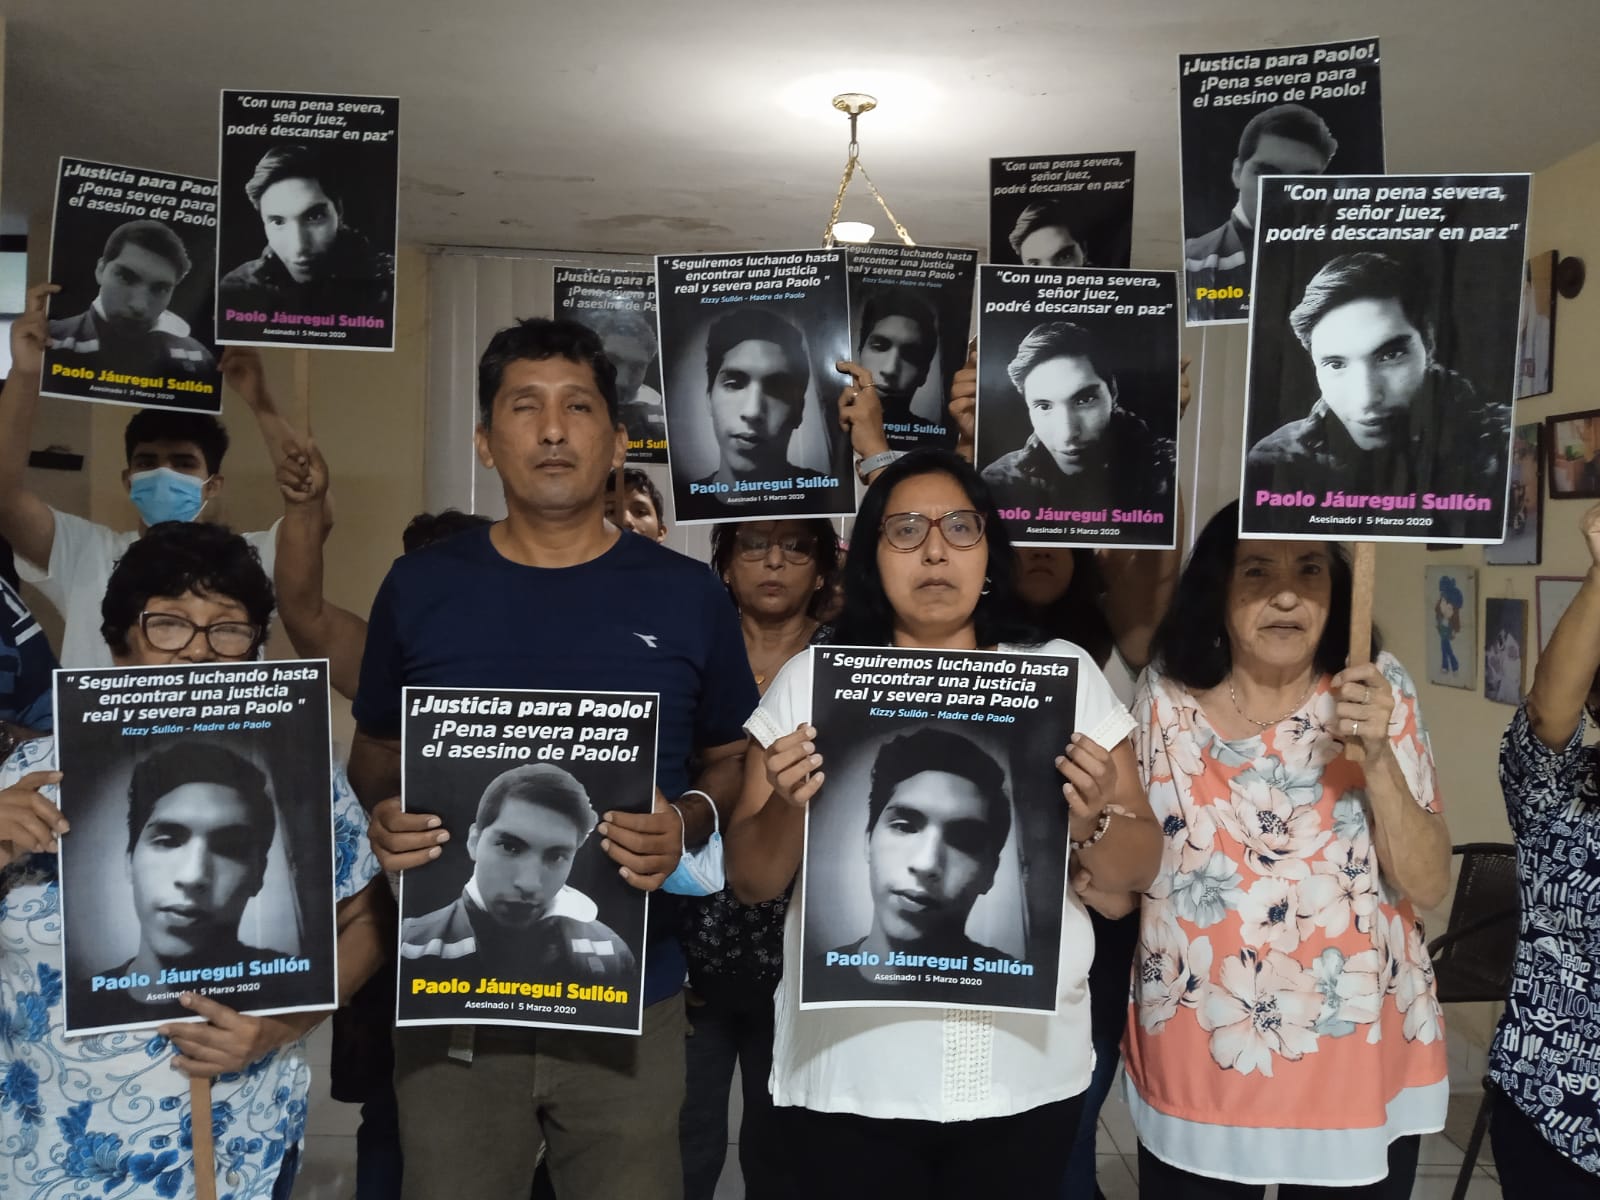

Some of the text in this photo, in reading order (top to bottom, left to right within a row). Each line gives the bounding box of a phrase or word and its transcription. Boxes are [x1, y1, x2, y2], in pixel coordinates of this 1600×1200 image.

[1183, 44, 1375, 76] ¡Justicia para Paolo!
[1200, 68, 1357, 93] ¡Pena severa para
[1193, 81, 1367, 107] el asesino de Paolo!
[238, 96, 385, 115] "Con una pena severa,
[273, 112, 347, 127] señor juez,
[227, 124, 394, 142] podré descansar paz"
[1002, 158, 1123, 171] "Con una pena severa,
[64, 164, 218, 196] ¡Justicia para Paol
[1031, 170, 1091, 182] señor juez,
[993, 179, 1130, 196] podré descansar paz"
[1284, 185, 1505, 202] "Con una pena severa,
[77, 182, 215, 212] ¡Pena severa para
[87, 199, 146, 216] asesino
[1336, 204, 1446, 222] señor juez,
[1266, 224, 1518, 242] podré descansar en paz"
[672, 253, 839, 270] Seguiremos luchando hasta
[853, 256, 955, 270] encontrar justicia
[900, 248, 973, 261] luchando hasta
[556, 271, 642, 285] ¡Justicia para
[685, 265, 818, 281] encontrar una justicia
[905, 270, 956, 280] para Paolo
[996, 271, 1161, 288] "Con una pena severa,
[674, 277, 821, 294] real severa para Paolo
[1197, 286, 1243, 300] Paolo
[1037, 288, 1120, 301] señor juez,
[985, 300, 1173, 316] podré descansar en paz"
[226, 309, 385, 329] Paolo Jáuregui Sullón
[52, 364, 213, 394] Paolo Jáuregui Sullón
[913, 424, 946, 436] Sullón
[690, 476, 839, 494] Paolo Jáuregui Sullón
[1256, 490, 1491, 511] Paolo Jáuregui Sullón
[1035, 507, 1164, 524] Jáuregui Sullón
[1309, 515, 1432, 526] Asesinado Marzo 2020
[1026, 526, 1062, 534] Asesinado
[1100, 528, 1120, 536] 2020
[832, 653, 1069, 677] Seguiremos luchando hasta
[78, 668, 318, 690] Seguiremos luchando hasta
[851, 672, 1036, 692] encontrar una justicia
[98, 685, 288, 706] encontrar una justicia
[834, 687, 1039, 709] real severa para Paolo
[82, 699, 293, 722] real severa para Paolo
[410, 696, 652, 718] ¡Justicia para Paolo!
[870, 707, 1015, 724] Kizzy Sullón Madre Paolo
[121, 720, 272, 736] Kizzy Sullón Madre Paolo
[432, 720, 628, 742] ¡Pena severa para
[422, 742, 640, 762] el asesino de Paolo!
[826, 951, 1034, 976] Paolo Jáuregui Sullón
[92, 958, 310, 992] Paolo Jáuregui Sullón
[874, 972, 982, 986] Asesinado Marzo 2020
[412, 978, 628, 1004] Paolo Jáuregui Sullón
[464, 1000, 576, 1014] Asesinado Marzo 2020
